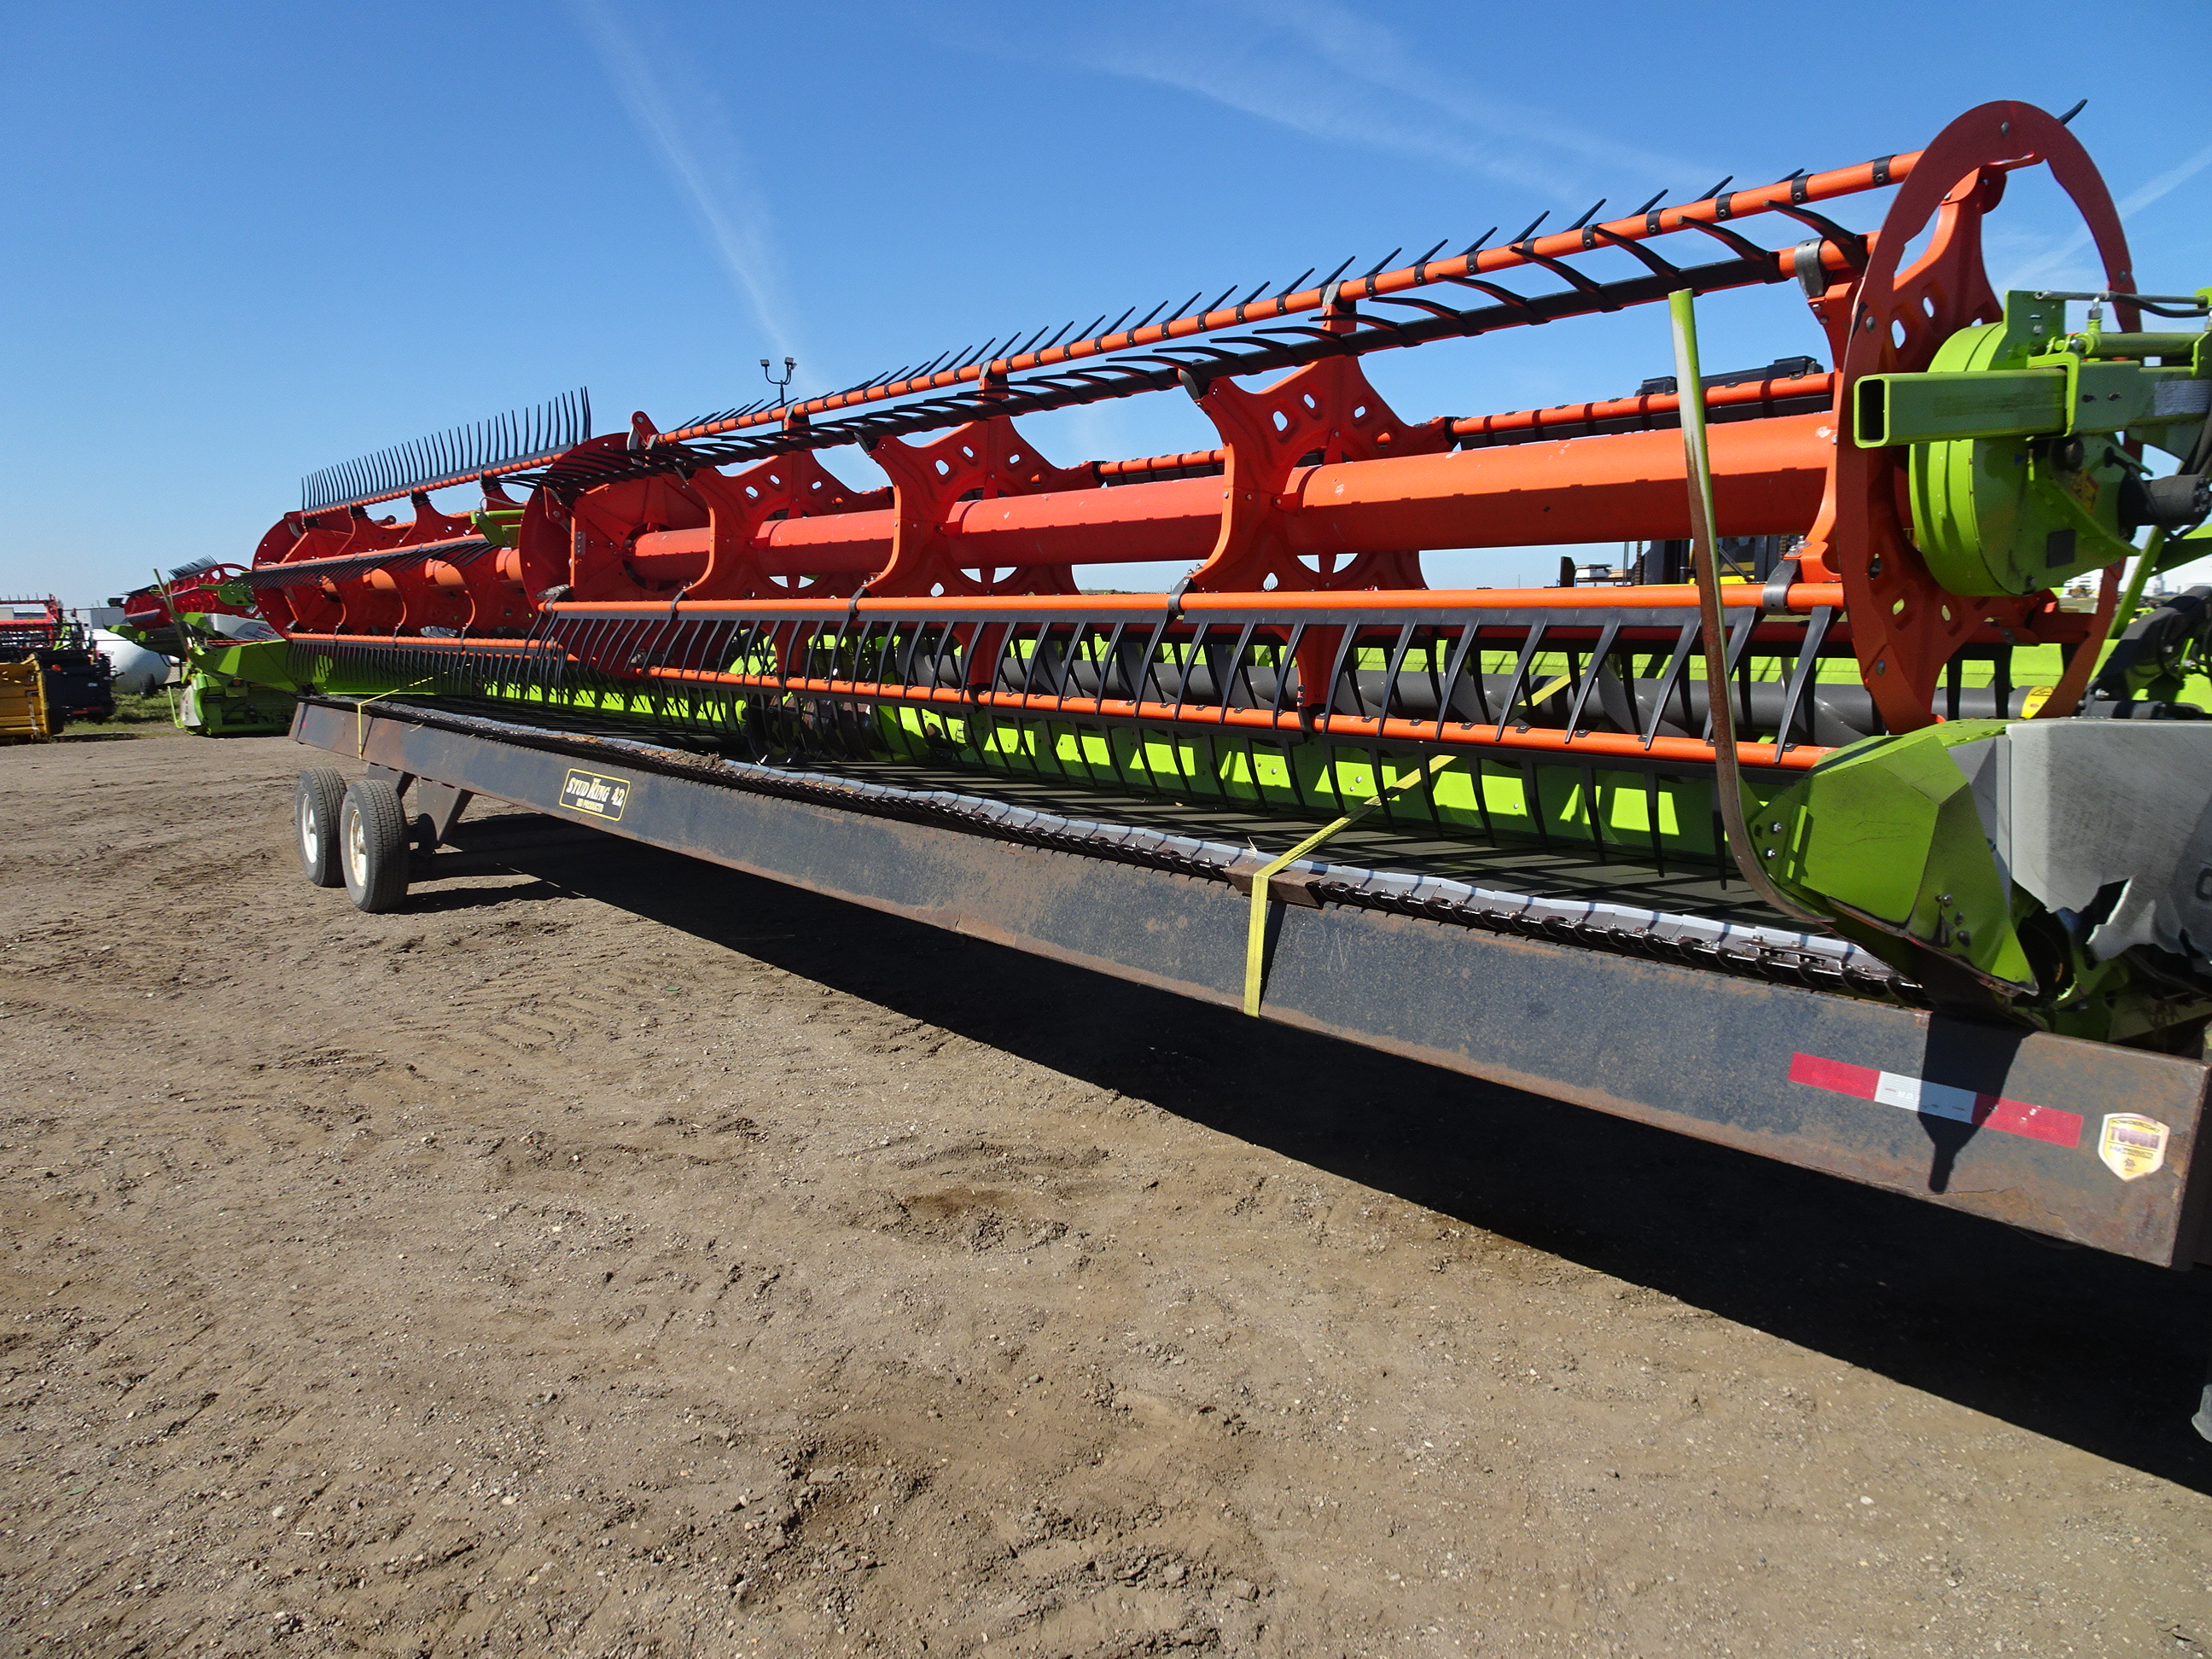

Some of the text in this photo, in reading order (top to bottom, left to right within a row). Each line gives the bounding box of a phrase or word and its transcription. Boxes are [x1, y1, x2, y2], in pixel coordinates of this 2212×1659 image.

[566, 777, 590, 796] STUD
[586, 781, 611, 802] KING
[611, 786, 626, 808] 42
